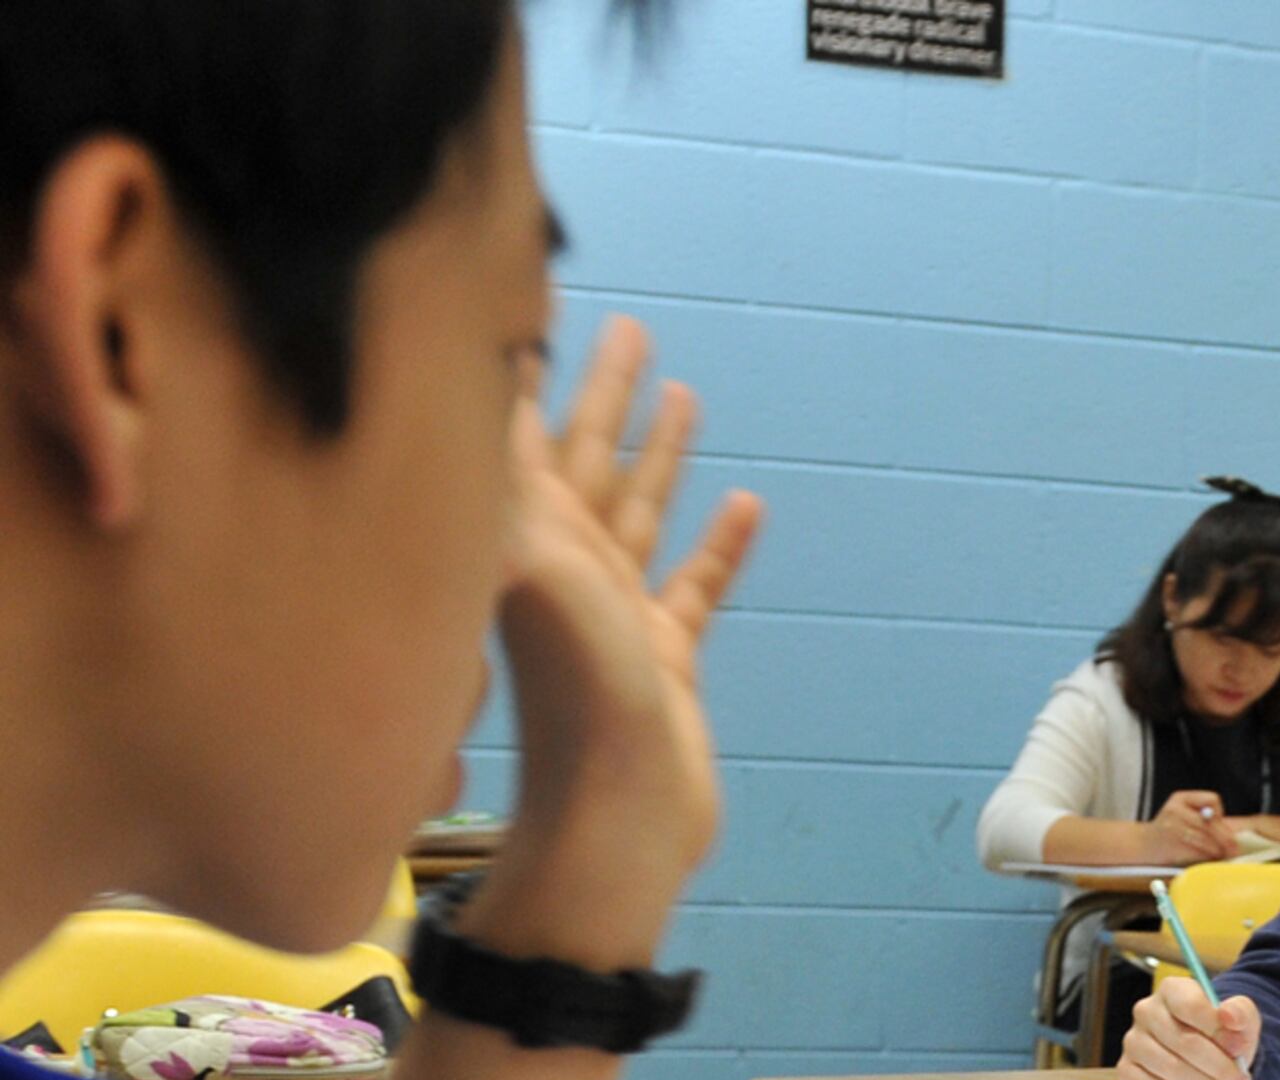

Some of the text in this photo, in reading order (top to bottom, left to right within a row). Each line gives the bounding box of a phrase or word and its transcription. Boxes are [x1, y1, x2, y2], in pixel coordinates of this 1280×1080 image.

[811, 8, 986, 44] renegade radical
[811, 32, 996, 67] visionary dreamer
